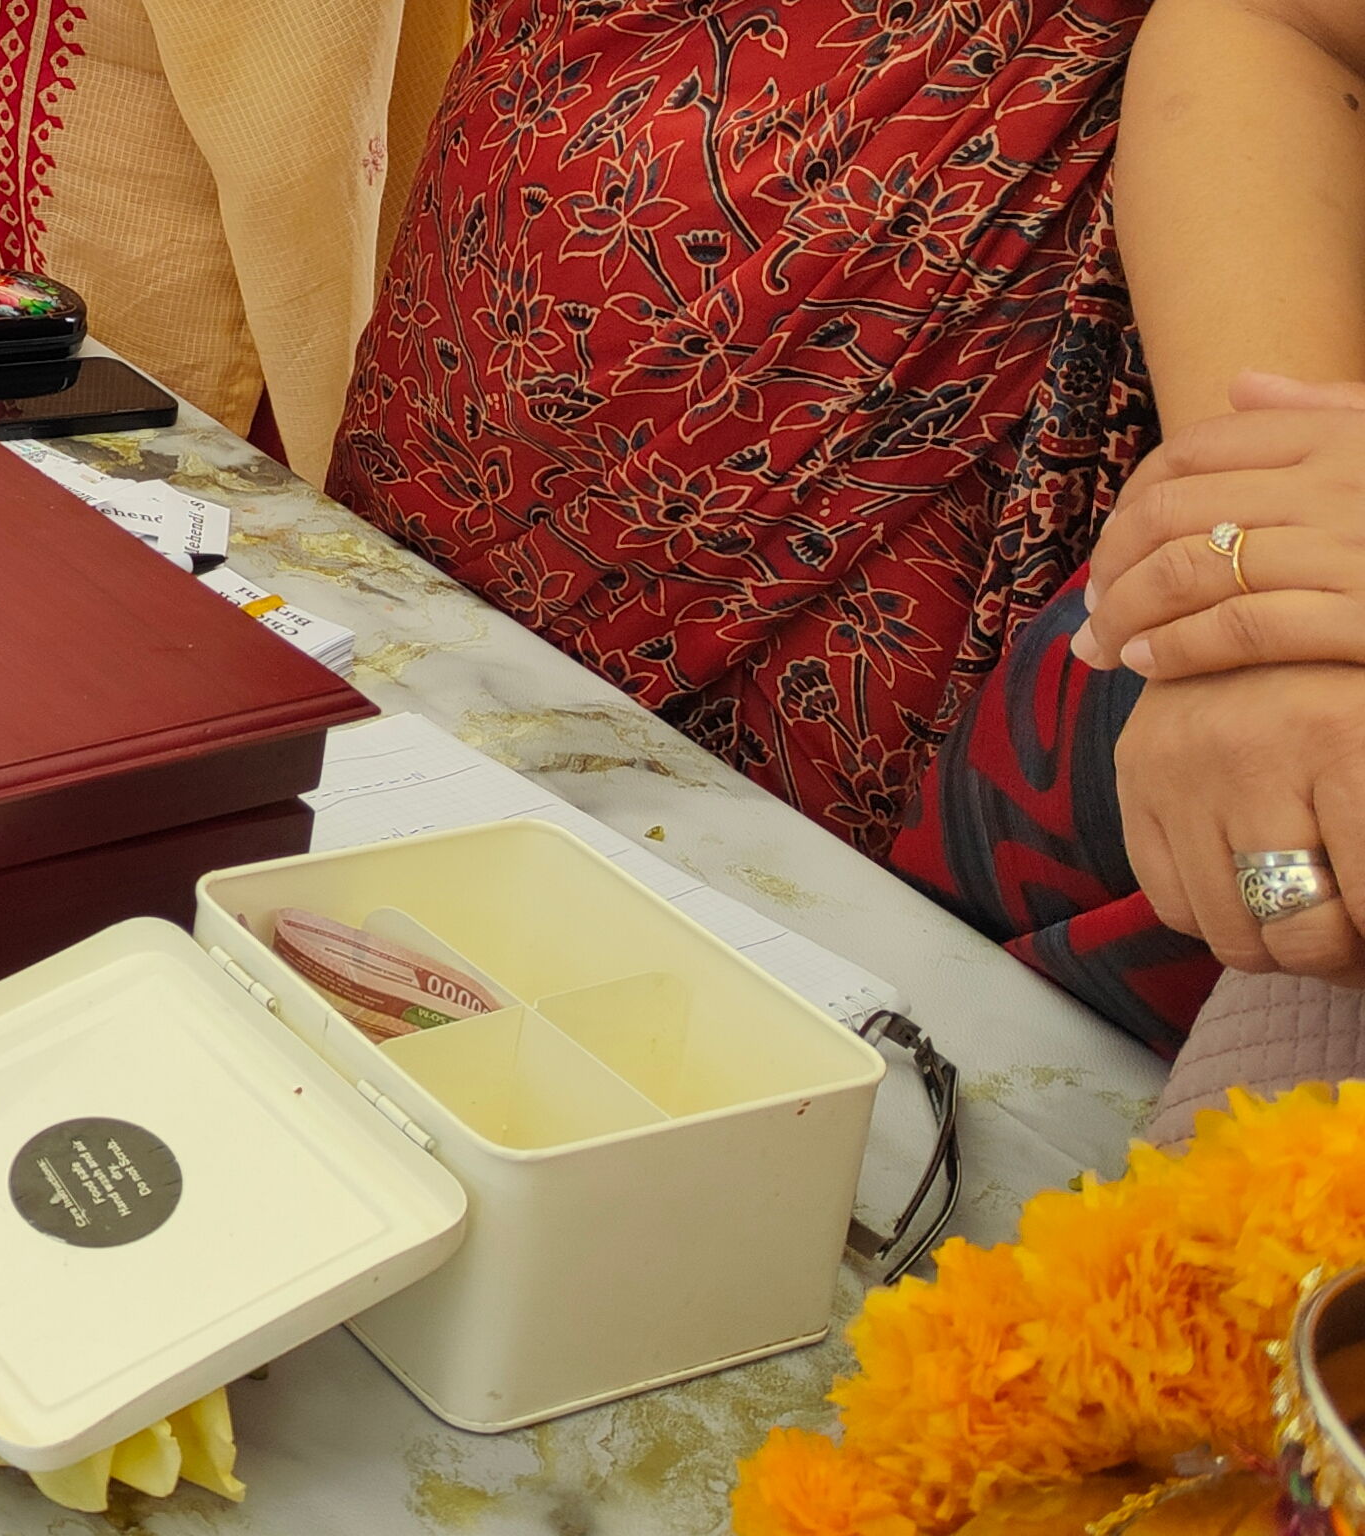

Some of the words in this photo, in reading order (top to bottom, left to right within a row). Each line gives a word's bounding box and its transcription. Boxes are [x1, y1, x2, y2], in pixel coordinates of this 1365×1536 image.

[235, 587, 314, 627] Biryni
[72, 1140, 87, 1153] air
[79, 1152, 99, 1169] and
[71, 1161, 90, 1181] safe
[93, 1168, 115, 1193] wash
[124, 1165, 142, 1182] not
[83, 1180, 107, 1205] Food
[137, 1180, 152, 1197] Do
[107, 1192, 132, 1217] Hand
[69, 1207, 86, 1228] Care
